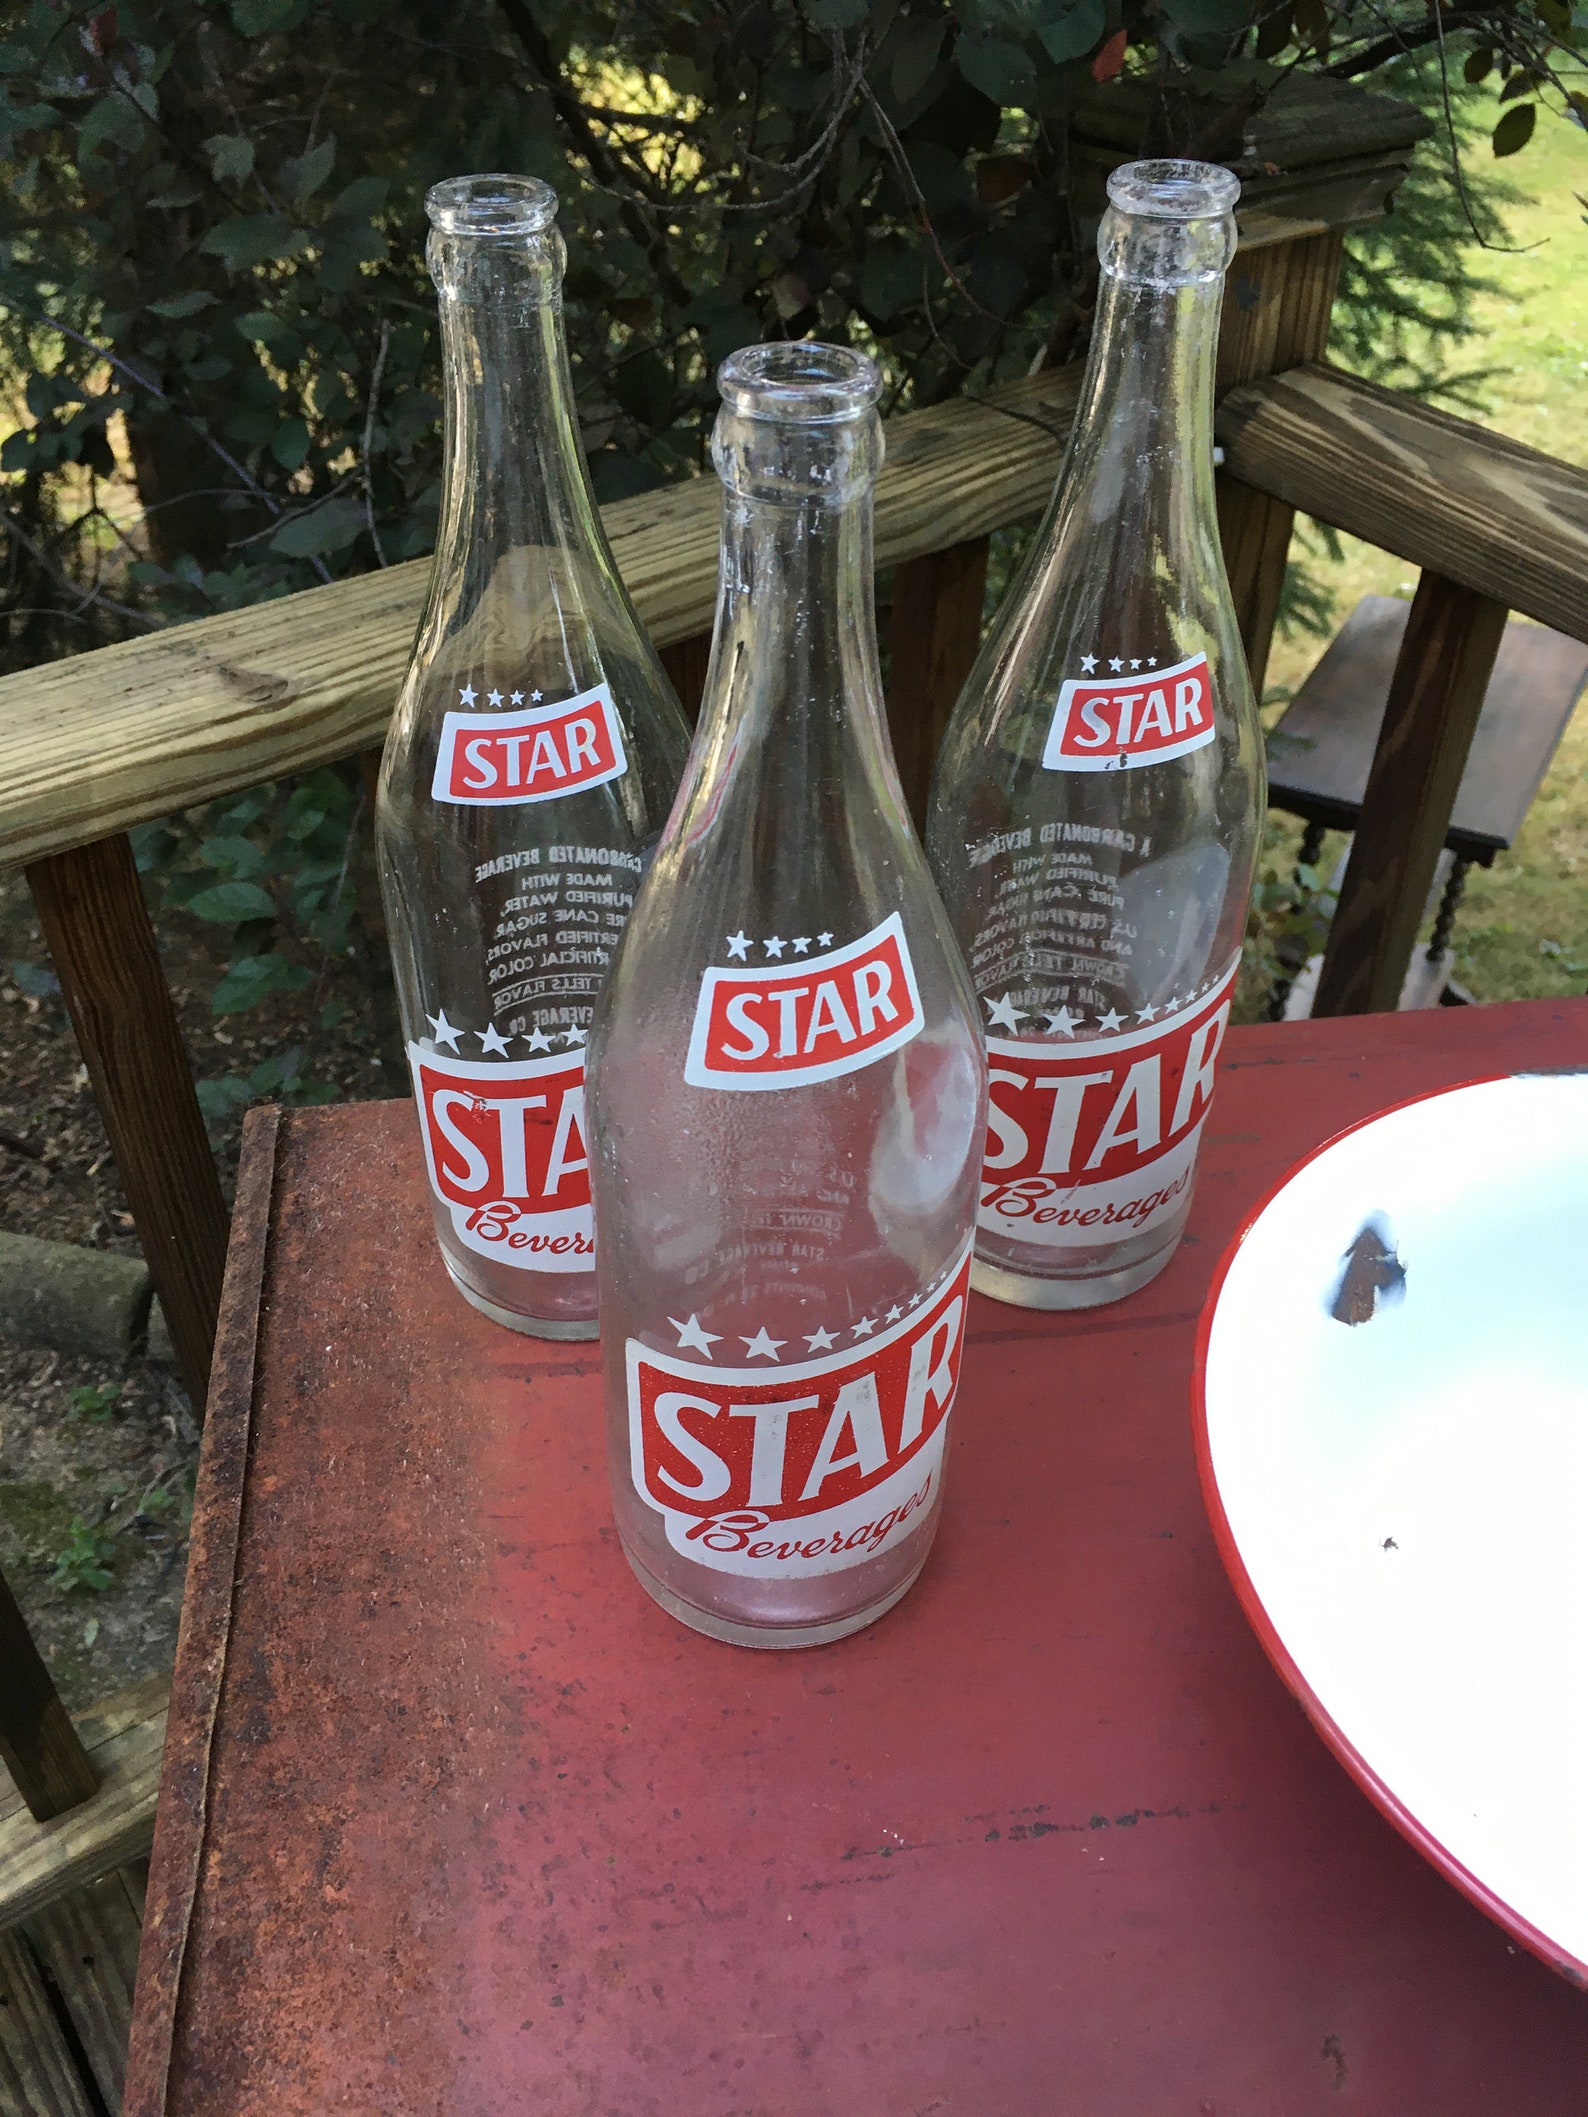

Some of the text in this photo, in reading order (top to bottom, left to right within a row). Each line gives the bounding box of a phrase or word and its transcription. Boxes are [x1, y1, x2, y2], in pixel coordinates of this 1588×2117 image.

[462, 718, 602, 789] STAR
[1073, 678, 1203, 748] STAR
[717, 961, 900, 1060] STAR
[981, 999, 1230, 1174] STAR
[432, 1085, 590, 1198] STA
[465, 1200, 594, 1255] Bever
[980, 1163, 1192, 1229] Beverages
[654, 1295, 963, 1507] STAR
[685, 1467, 933, 1560] Beverages
